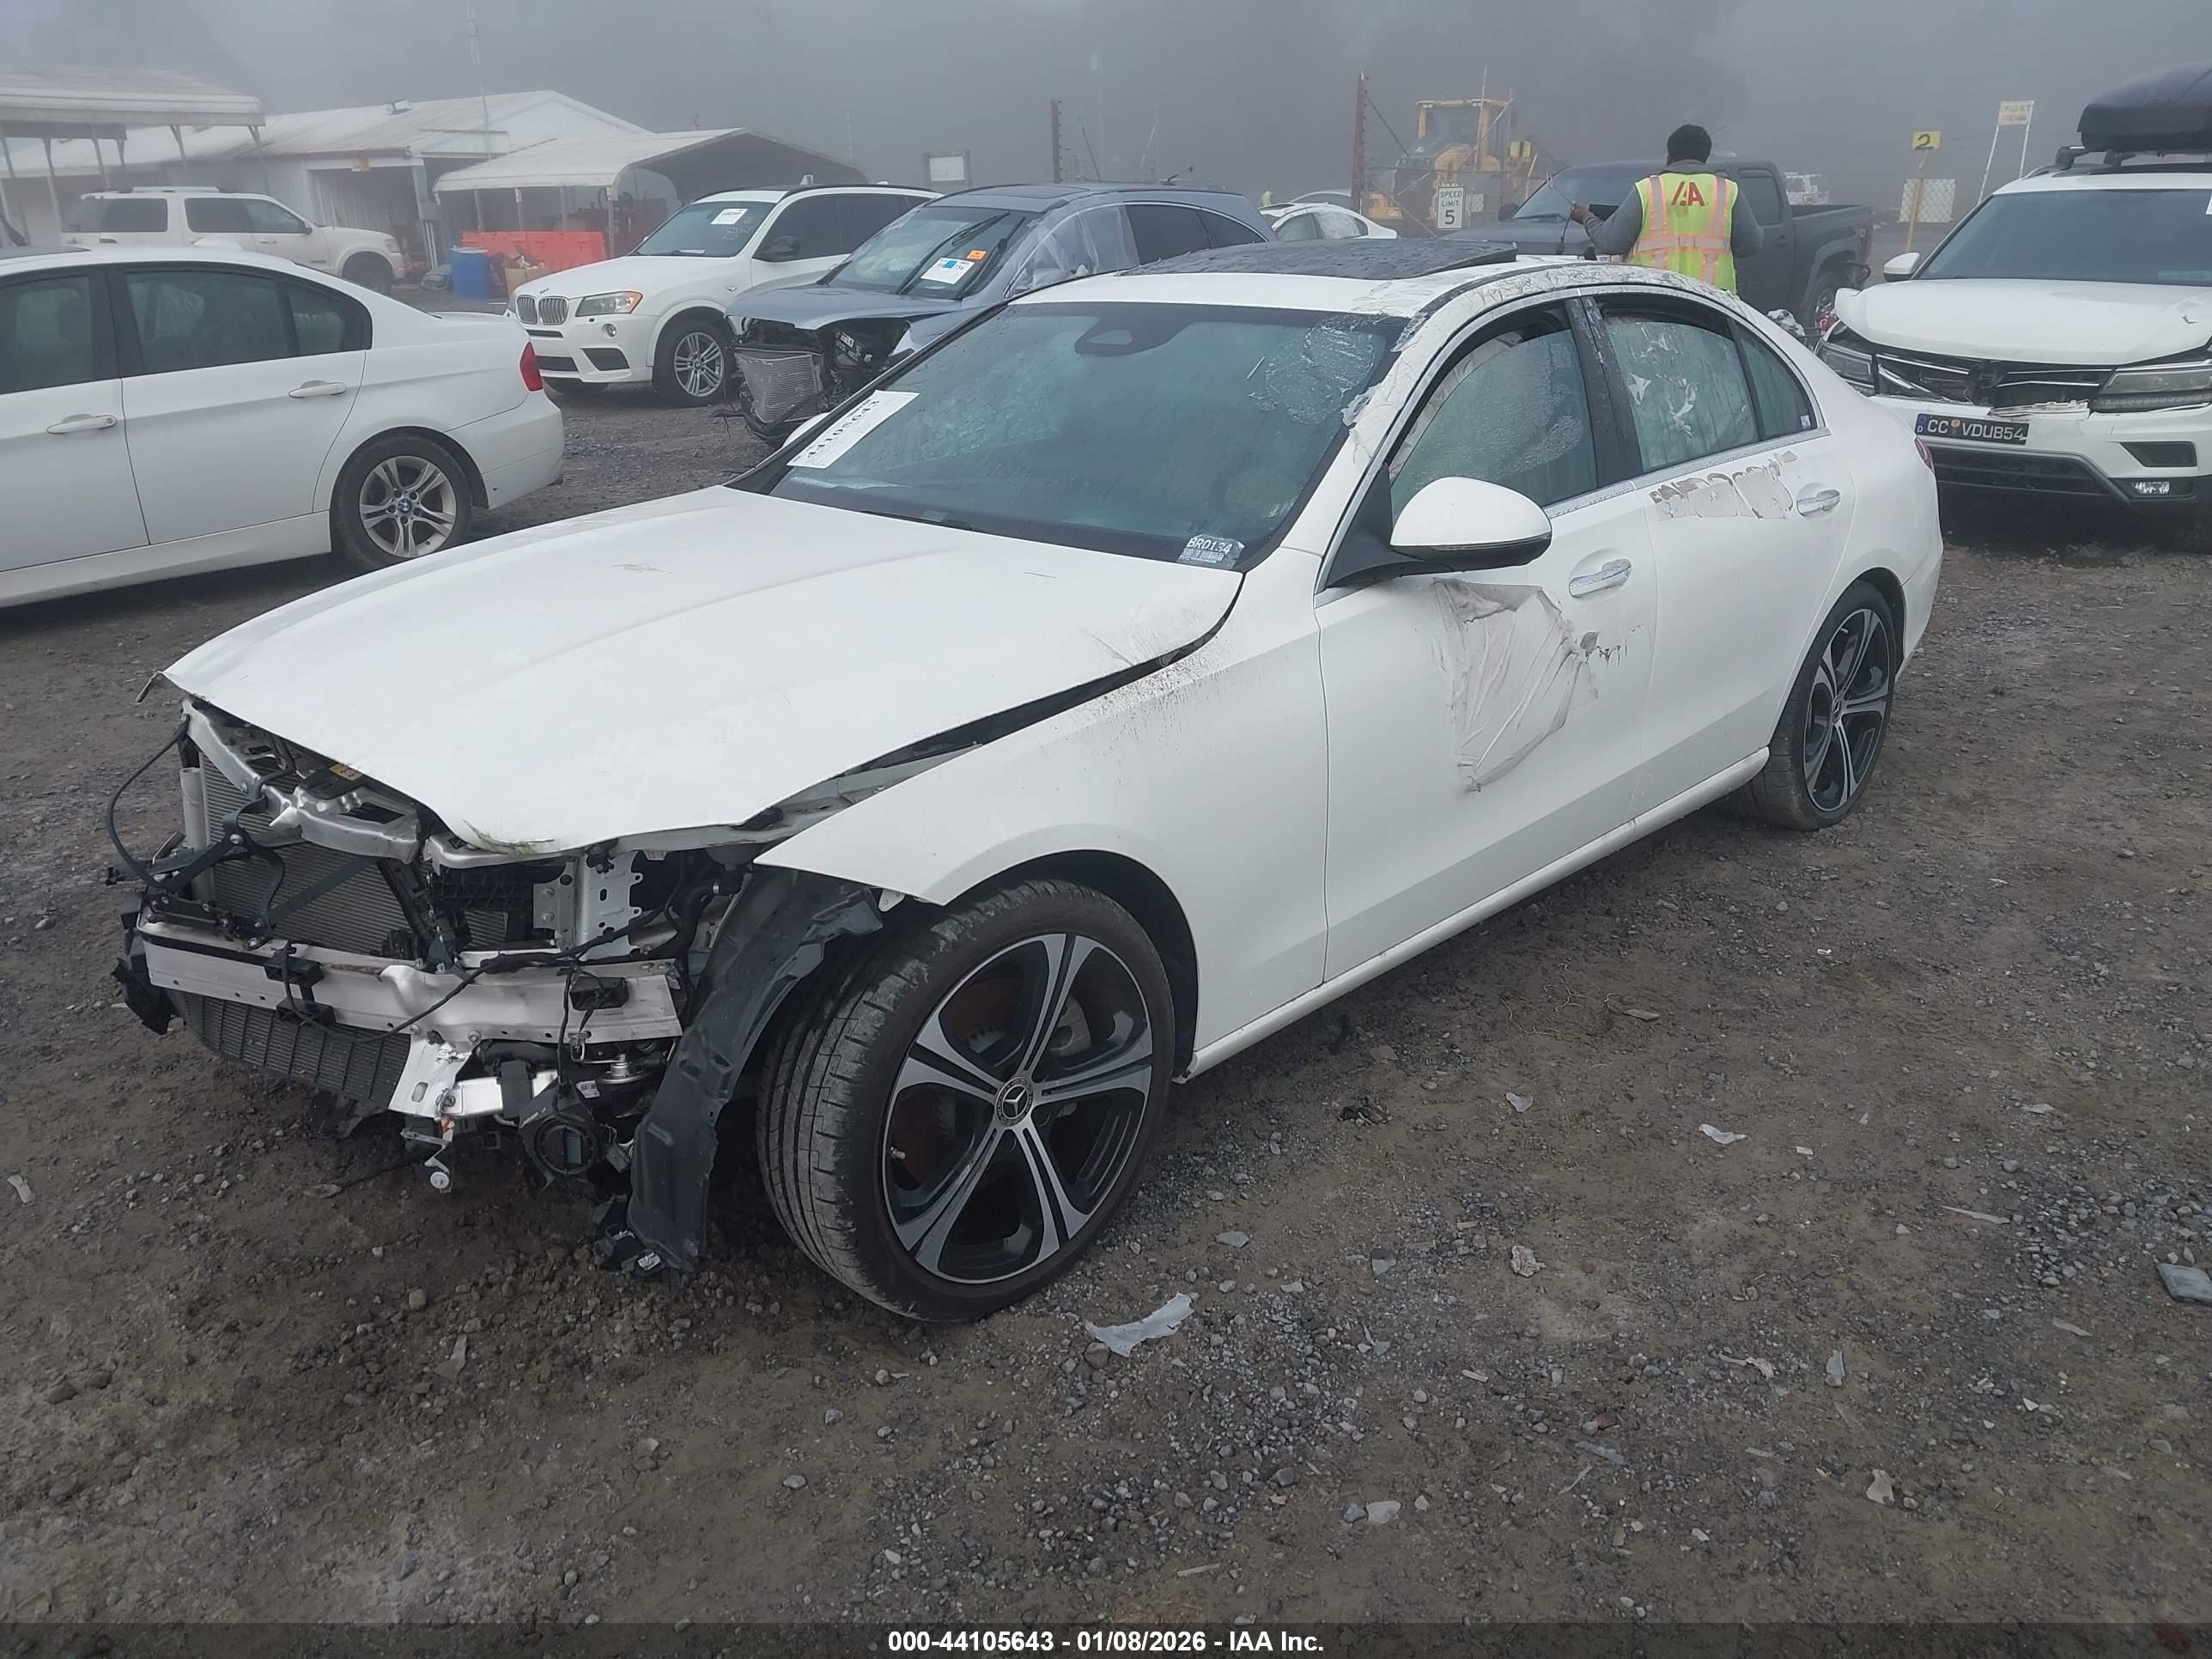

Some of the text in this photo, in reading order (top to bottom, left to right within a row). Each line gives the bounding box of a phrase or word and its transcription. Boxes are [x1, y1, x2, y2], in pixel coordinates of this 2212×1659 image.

[1914, 133, 1934, 150] 2
[1444, 210, 1455, 225] 5
[1927, 419, 1949, 434] CC
[1962, 422, 2025, 441] VDUB54
